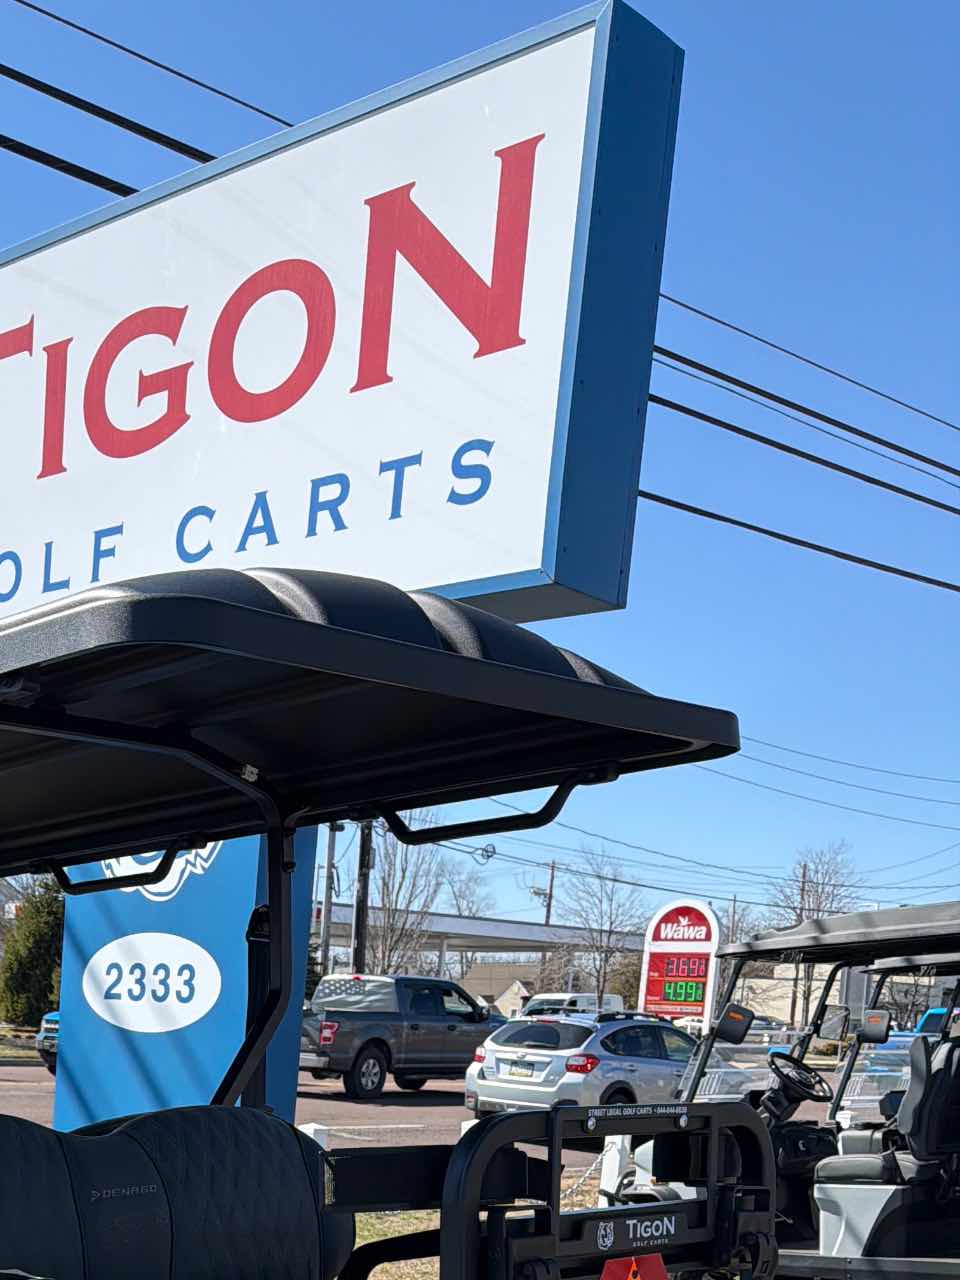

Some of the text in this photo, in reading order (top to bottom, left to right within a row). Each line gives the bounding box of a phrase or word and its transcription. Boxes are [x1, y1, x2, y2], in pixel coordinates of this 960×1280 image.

[174, 439, 496, 563] CARTS
[660, 922, 707, 940] Wawa
[103, 962, 196, 1004] 2333
[626, 1215, 676, 1239] TIGON
